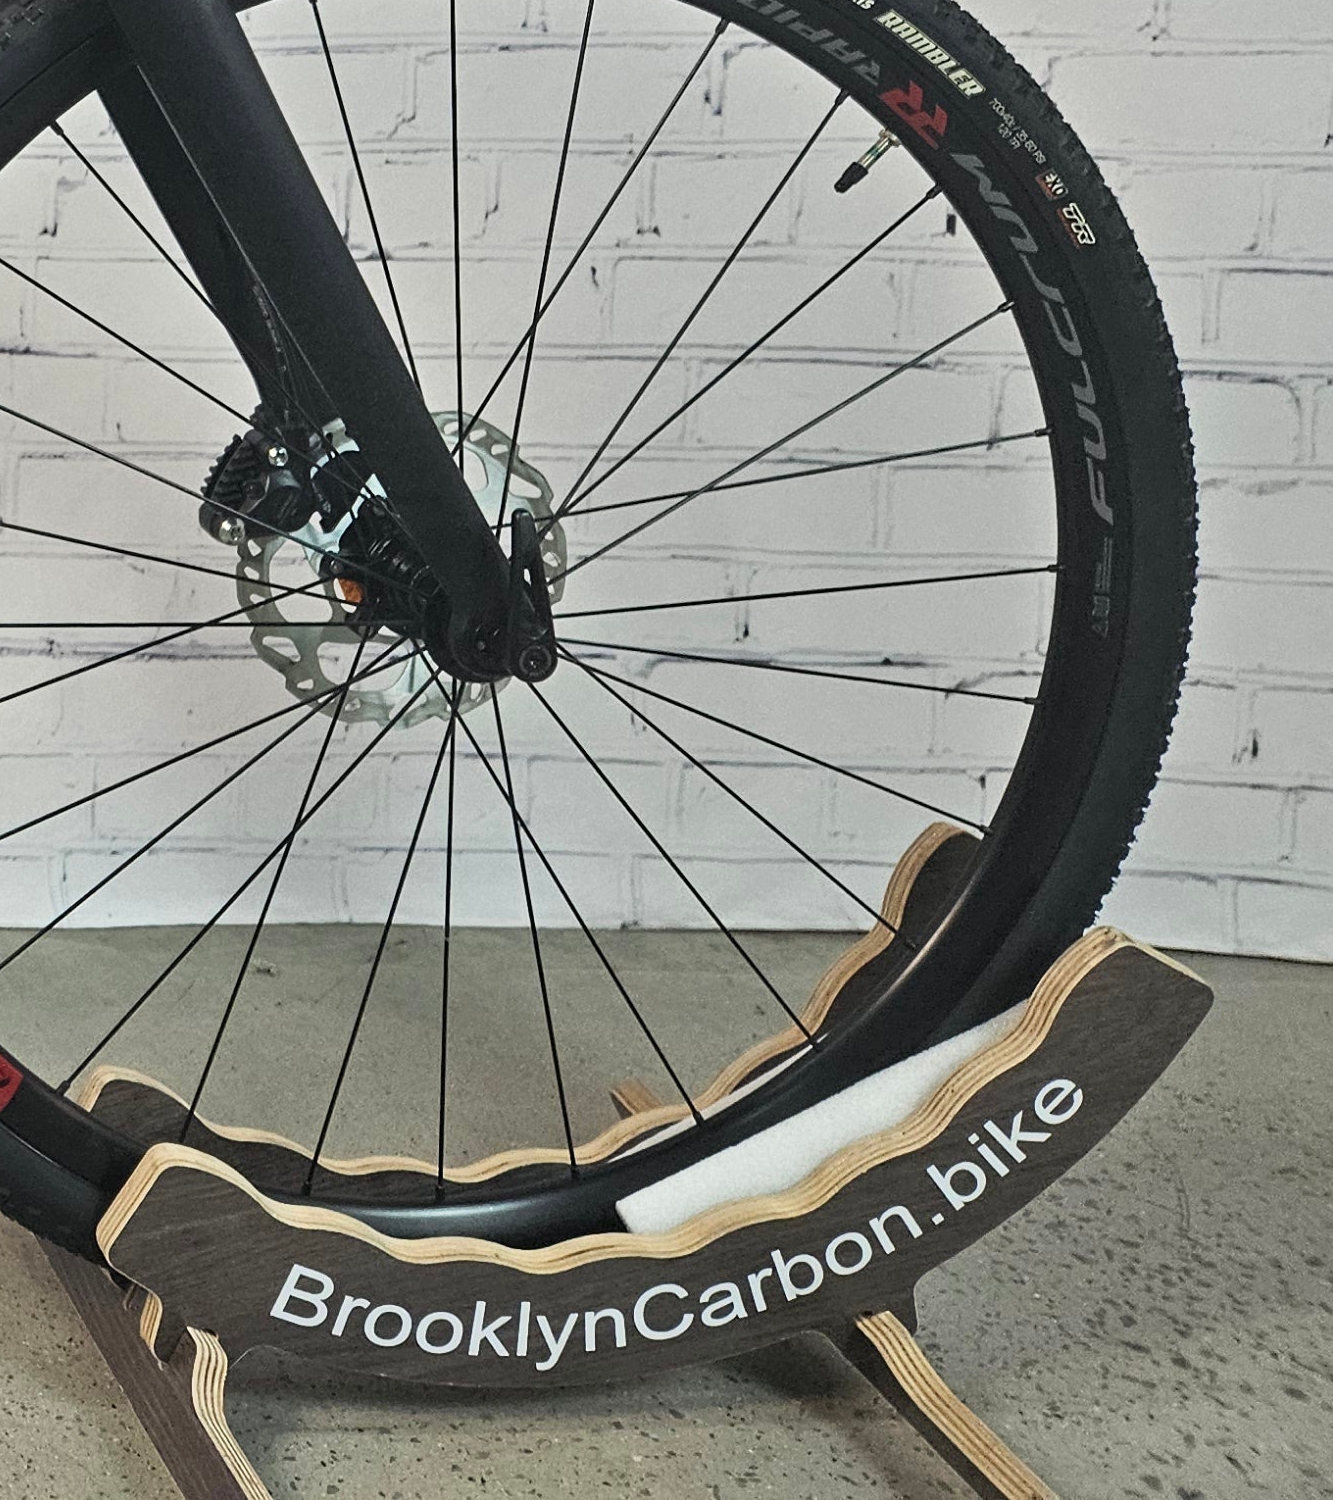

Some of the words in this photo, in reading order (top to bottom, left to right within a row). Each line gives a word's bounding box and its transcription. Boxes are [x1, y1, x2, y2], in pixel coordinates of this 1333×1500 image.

[874, 9, 986, 99] RAMBLER
[949, 153, 1114, 525] FULCRUM
[268, 1075, 1085, 1372] BrooklynCarbon.bike
